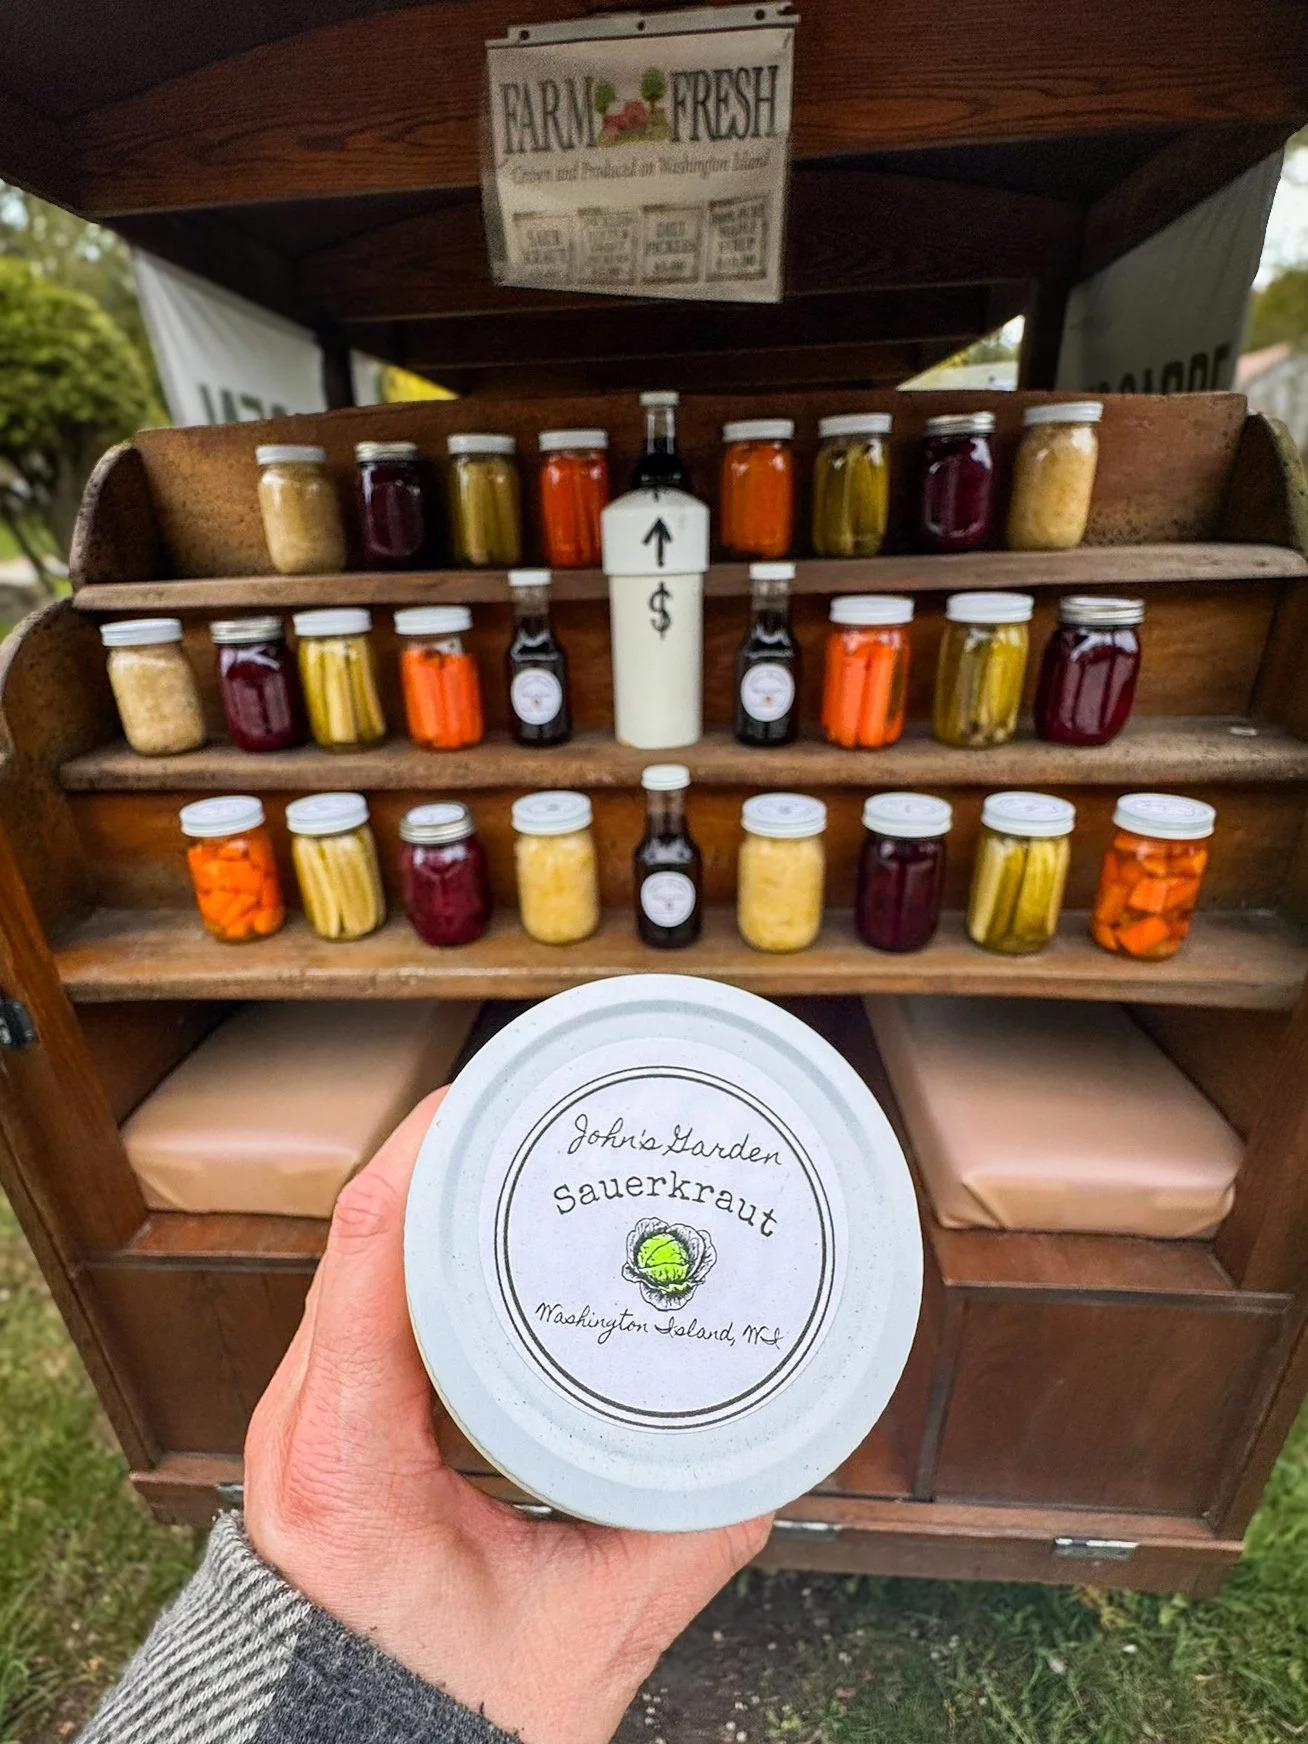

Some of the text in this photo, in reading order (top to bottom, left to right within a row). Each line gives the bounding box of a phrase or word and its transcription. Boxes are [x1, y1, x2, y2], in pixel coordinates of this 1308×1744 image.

[500, 66, 779, 155] FARM FRESH
[658, 154, 728, 180] Washington
[732, 150, 771, 172] Island
[648, 580, 672, 638] $
[567, 1113, 782, 1166] John's Garden
[553, 1170, 778, 1237] Sauerkraut
[535, 1301, 784, 1350] Washington Island, WI
